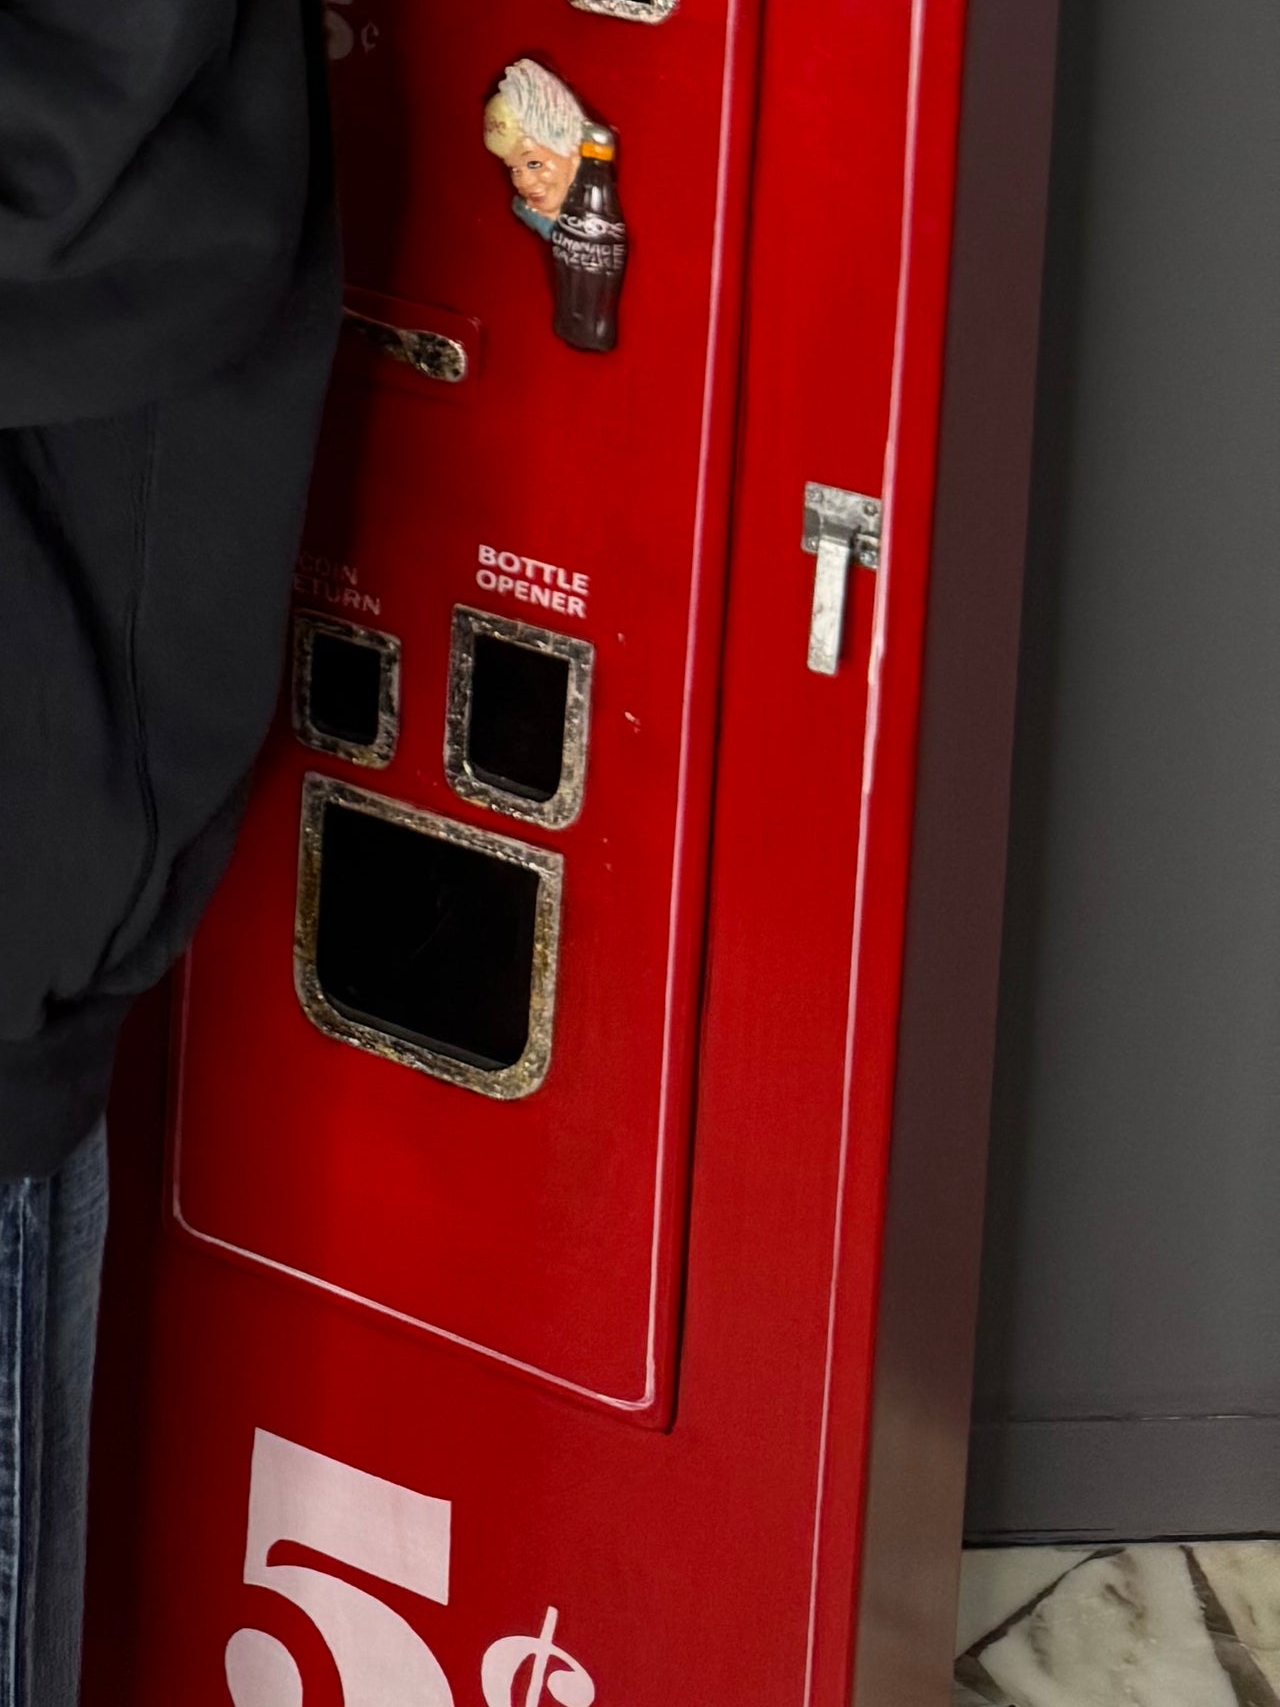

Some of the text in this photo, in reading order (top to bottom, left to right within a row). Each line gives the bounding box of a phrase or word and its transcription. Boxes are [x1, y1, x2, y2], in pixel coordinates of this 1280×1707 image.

[292, 573, 382, 617] ETURN
[476, 569, 587, 619] OPENER
[478, 544, 590, 596] BOTTLE
